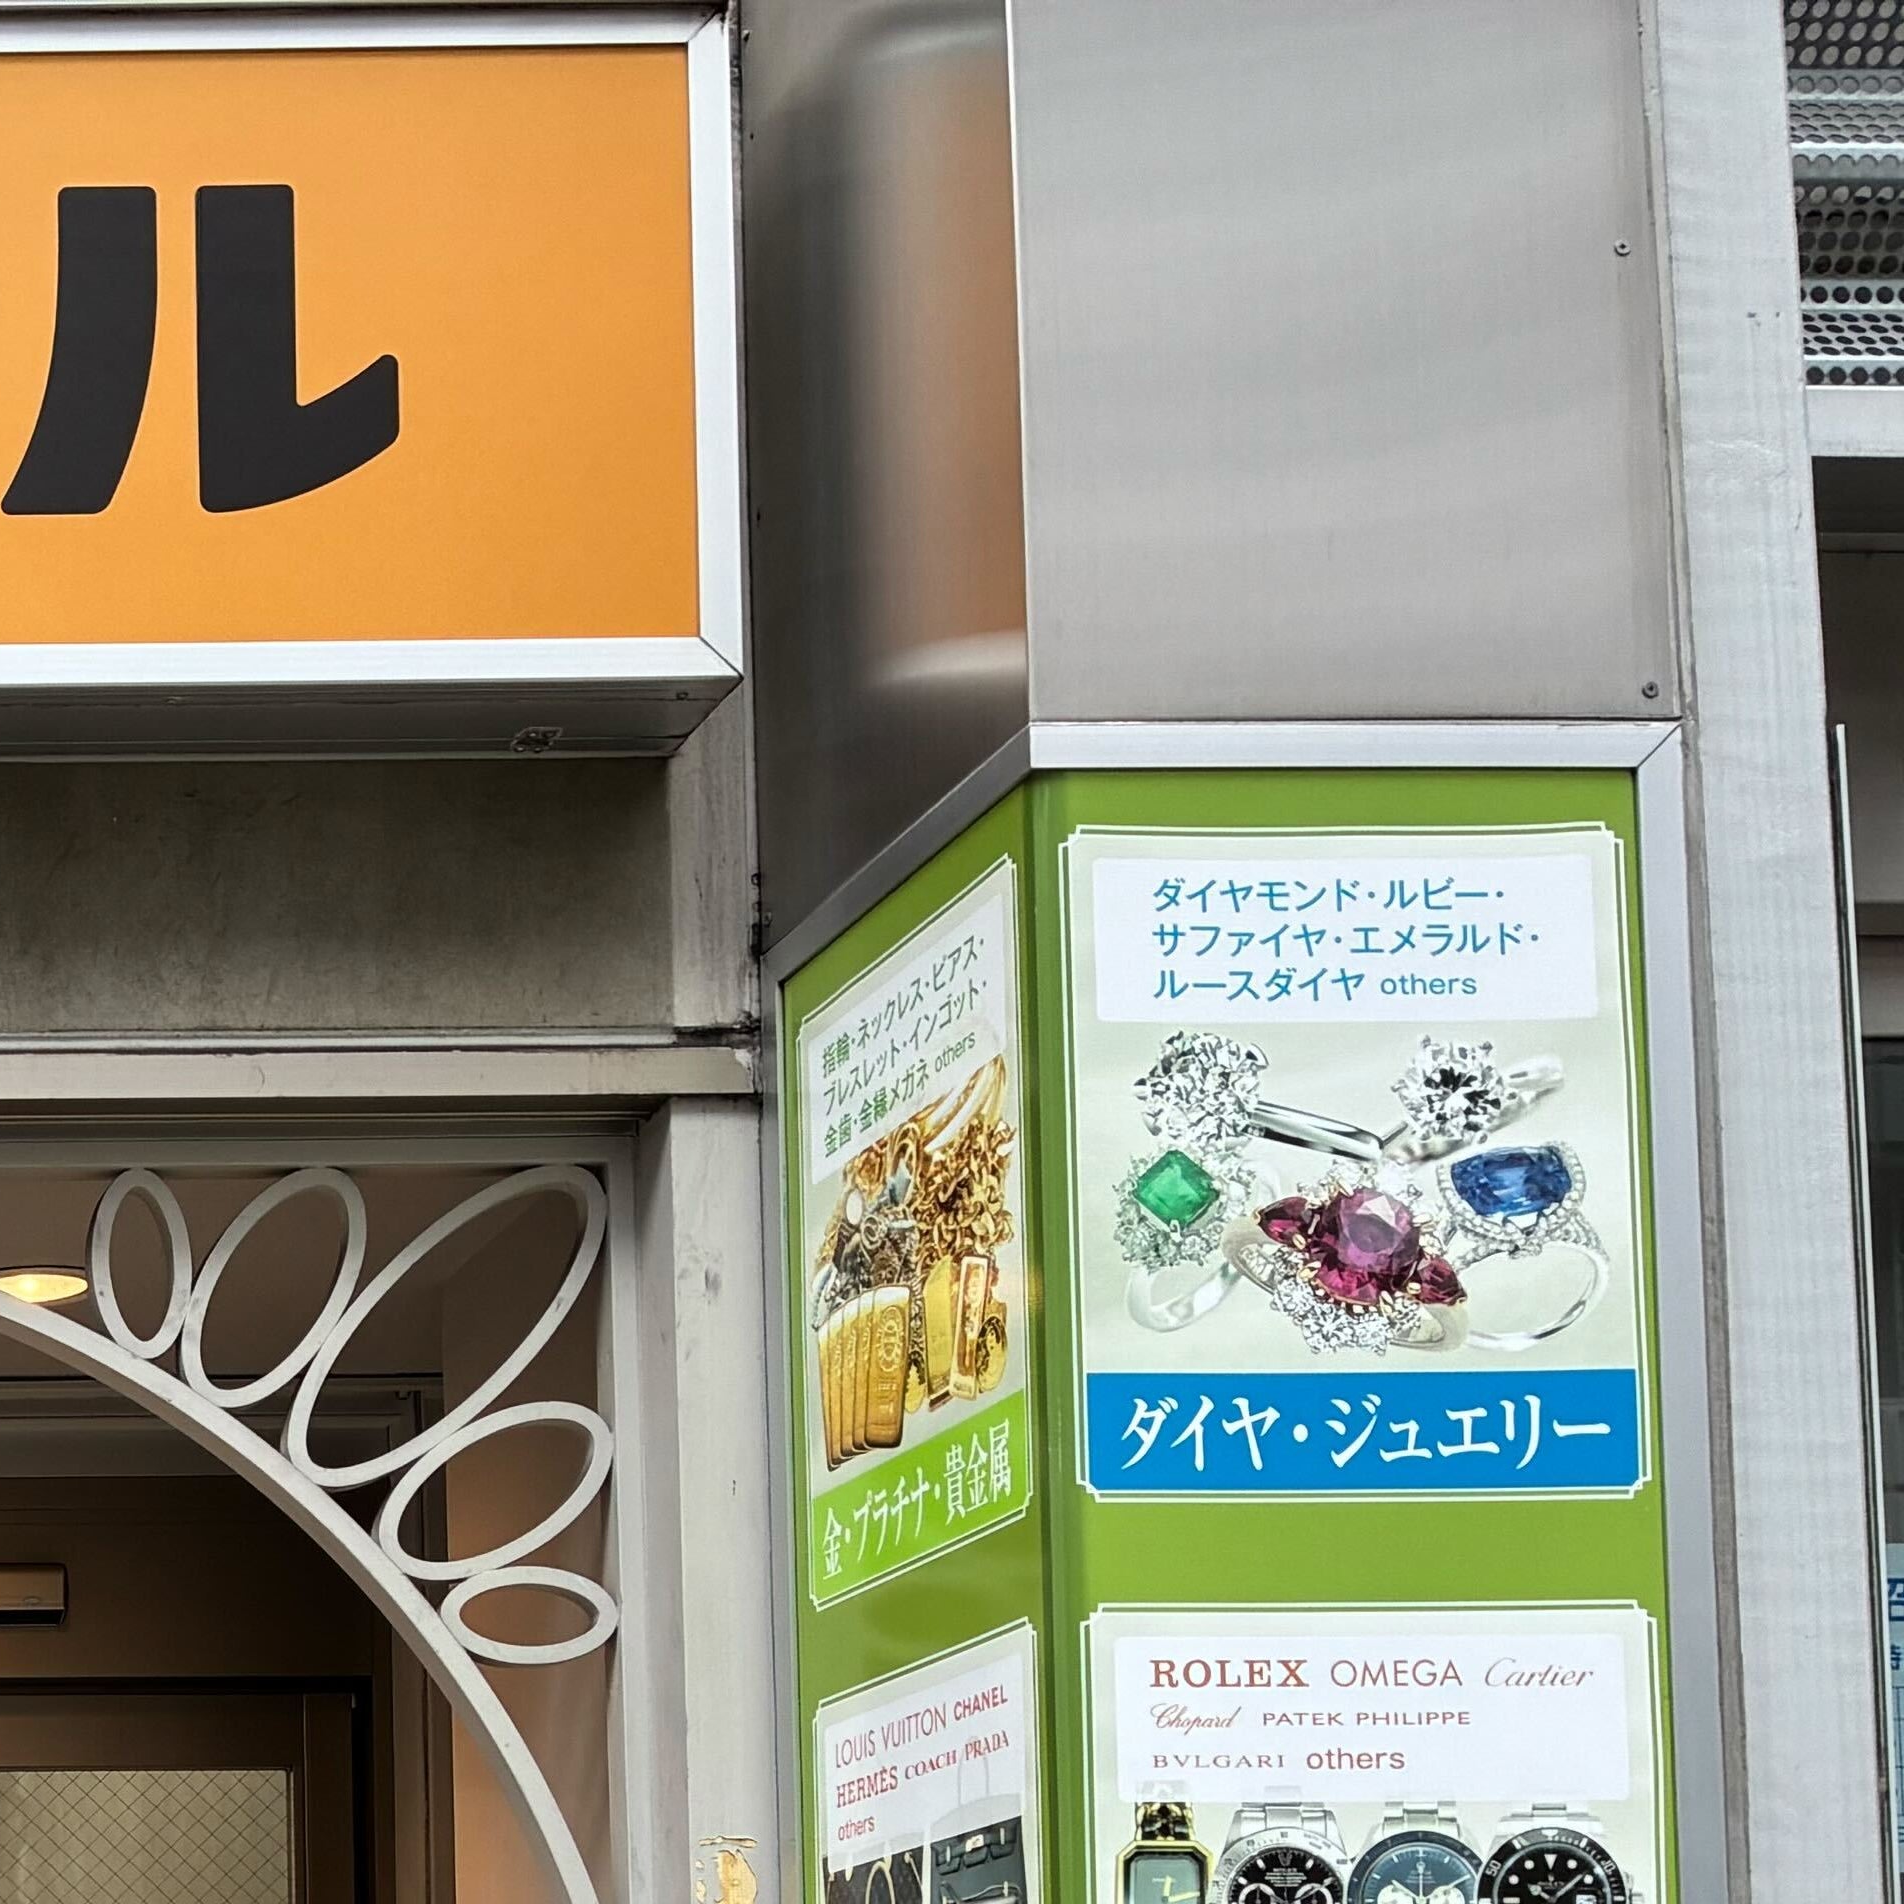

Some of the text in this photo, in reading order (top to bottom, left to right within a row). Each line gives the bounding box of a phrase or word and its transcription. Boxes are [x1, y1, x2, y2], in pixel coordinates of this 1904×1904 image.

[1153, 967, 1477, 1001] ルースダイヤ others
[935, 1031, 975, 1072] others
[1121, 1394, 1611, 1472] ダイヤ・ジュエリー
[823, 1418, 1011, 1579] 金・プラチナ・貴金属
[1149, 1657, 1594, 1689] ROLEX OMEGA Cartier
[836, 1684, 1008, 1768] LOUIS VUITTON CHANEL
[1150, 1703, 1471, 1735] Chopard PATEK PHILIPPE
[905, 1750, 957, 1780] COACH
[965, 1730, 1009, 1761] PRADA
[1153, 1748, 1405, 1770] BVLGARI others
[838, 1816, 875, 1841] others
